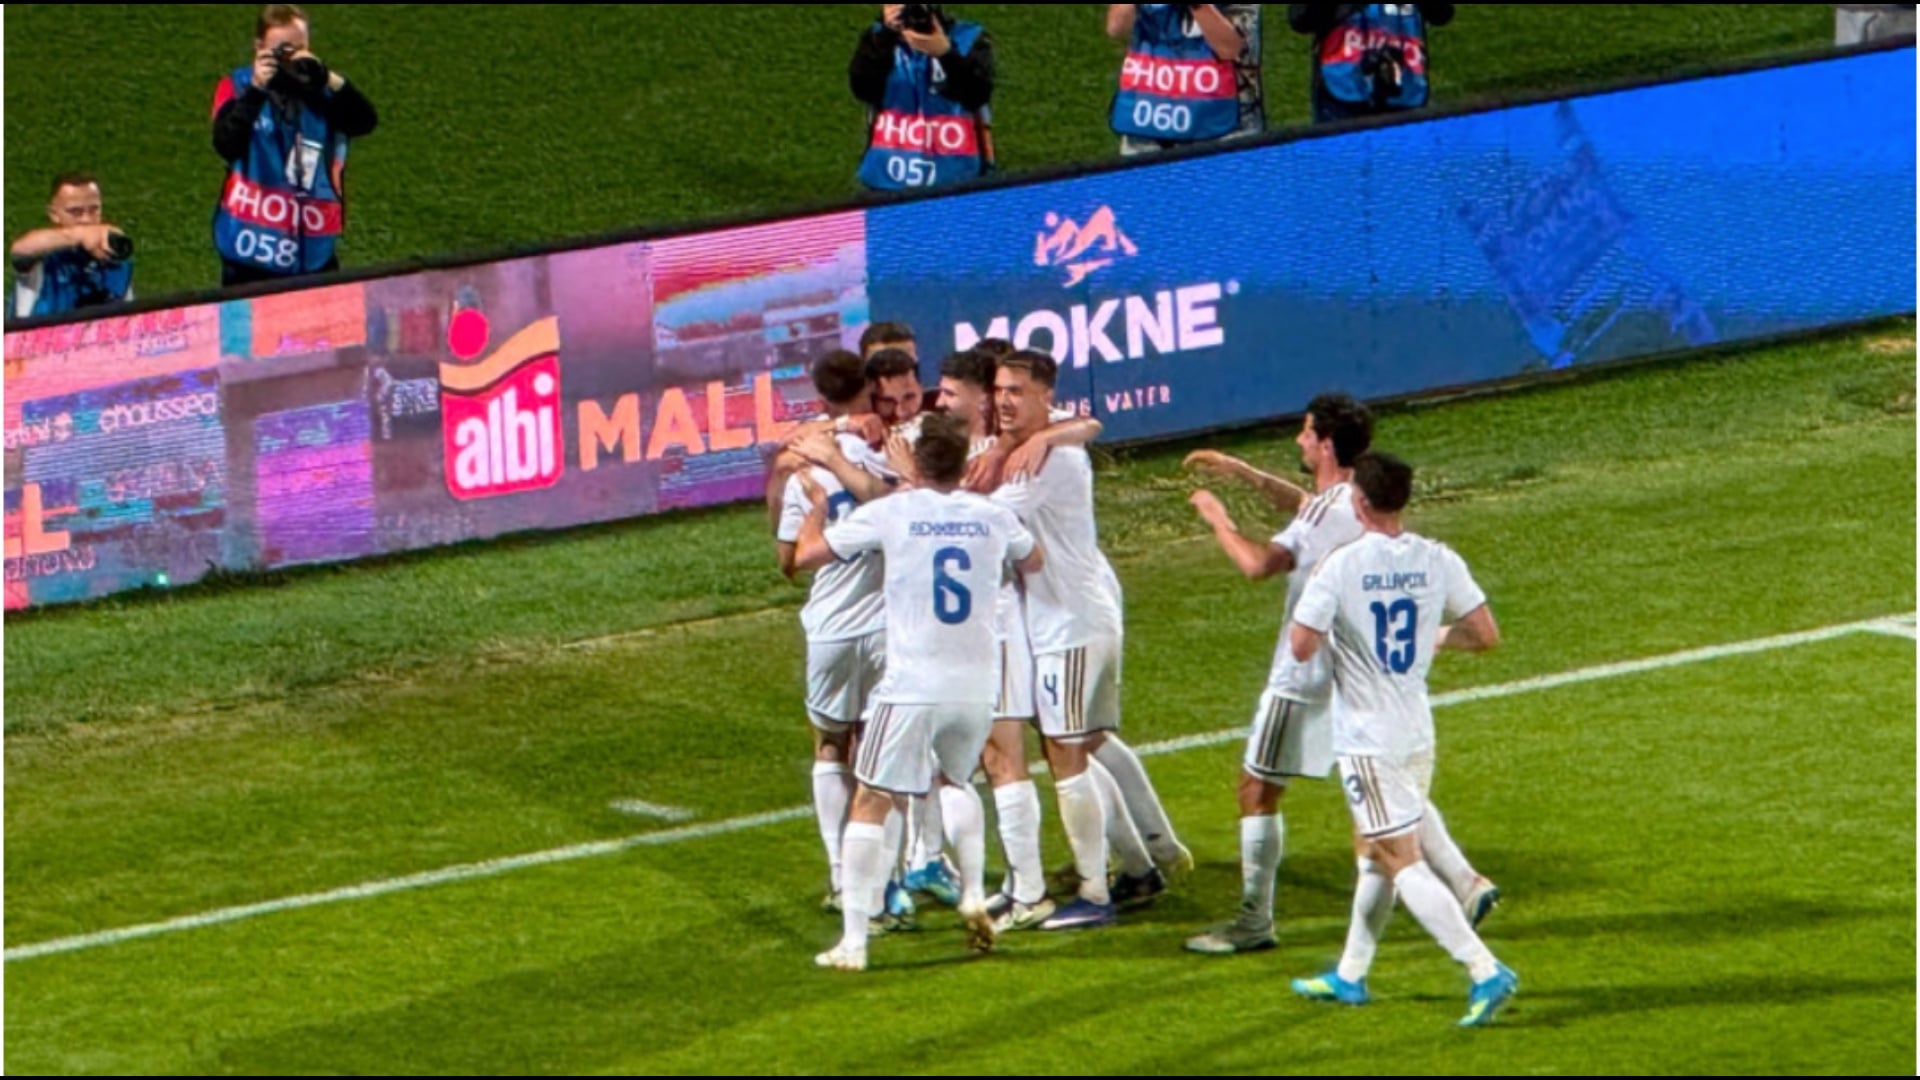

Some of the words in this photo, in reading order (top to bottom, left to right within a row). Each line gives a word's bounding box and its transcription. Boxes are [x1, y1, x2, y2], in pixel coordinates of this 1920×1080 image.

[1121, 56, 1219, 94] PHOTO
[1133, 99, 1192, 133] 060
[887, 155, 937, 187] 057
[228, 179, 325, 232] PHOTO
[234, 228, 298, 267] 058
[954, 282, 1224, 369] MOKNE
[454, 372, 556, 489] albi
[577, 371, 799, 471] MALL
[4, 482, 71, 559] L
[932, 545, 972, 625] 6
[1369, 597, 1418, 674] 13
[1043, 672, 1058, 706] 4
